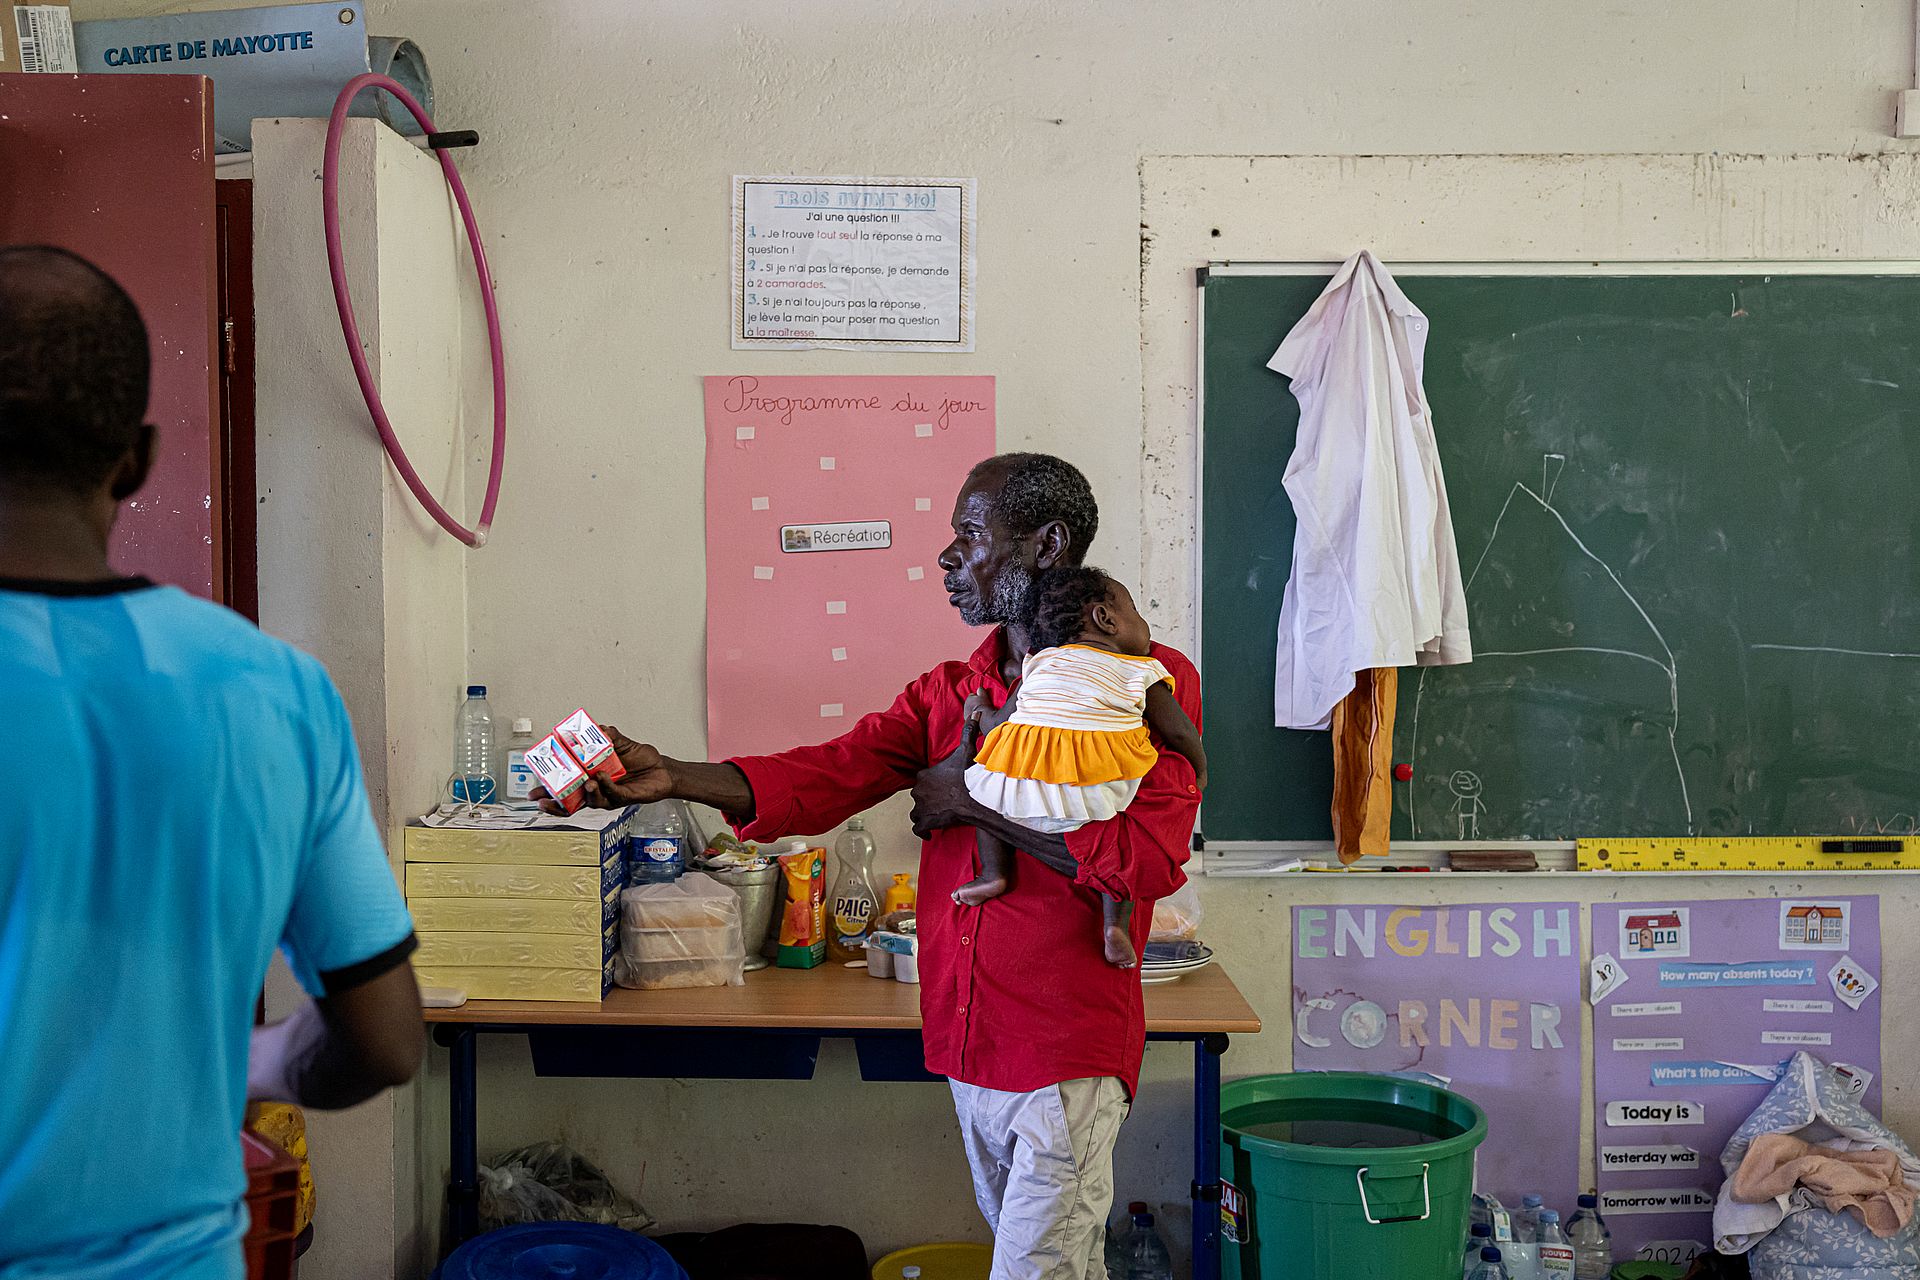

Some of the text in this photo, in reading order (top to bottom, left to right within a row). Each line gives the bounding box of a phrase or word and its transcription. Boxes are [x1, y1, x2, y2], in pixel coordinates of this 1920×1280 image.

[104, 31, 313, 66] CARTE DE MAYOTTE
[806, 212, 823, 221] J'ai
[847, 213, 888, 224] question
[891, 214, 900, 223] !!!
[767, 230, 780, 239] Je
[782, 229, 814, 239] trouve
[817, 230, 836, 239] tout
[839, 230, 858, 240] seul
[860, 231, 870, 240] la
[872, 232, 913, 244] réponse
[916, 232, 923, 241] à
[747, 246, 789, 255] question
[766, 264, 774, 272] Si
[776, 264, 786, 275] je
[788, 264, 806, 273] n'ai
[808, 265, 827, 275] pas
[829, 264, 838, 273] la
[887, 266, 897, 277] je
[900, 266, 949, 276] demande
[747, 279, 827, 289] à 2 camarades.
[762, 297, 770, 306] Si
[772, 298, 782, 308] je
[785, 298, 802, 306] n'ai
[805, 298, 846, 309] toujours
[848, 300, 866, 310] pas
[868, 299, 877, 308] la
[880, 299, 920, 310] réponse
[747, 313, 757, 324] je
[760, 312, 780, 322] lève
[783, 312, 792, 322] la
[794, 313, 819, 322] main
[822, 316, 846, 325] pour
[848, 316, 876, 325] poser
[898, 316, 940, 327] question
[747, 327, 818, 337] à la maîtresse.
[724, 375, 986, 430] Programme du jour
[814, 529, 890, 545] Récréation
[835, 898, 870, 917] PAIC
[1298, 907, 1572, 958] ENGLISH
[1660, 967, 1814, 982] How many absents today ?
[1296, 998, 1565, 1050] CORNER
[1654, 1067, 1697, 1079] What's
[1700, 1067, 1720, 1078] the
[1621, 1105, 1689, 1122] Today is
[1604, 1152, 1695, 1164] Yesterday was
[1603, 1197, 1666, 1207] Tomorrow
[1670, 1194, 1691, 1205] will
[1642, 1247, 1695, 1265] 2024
